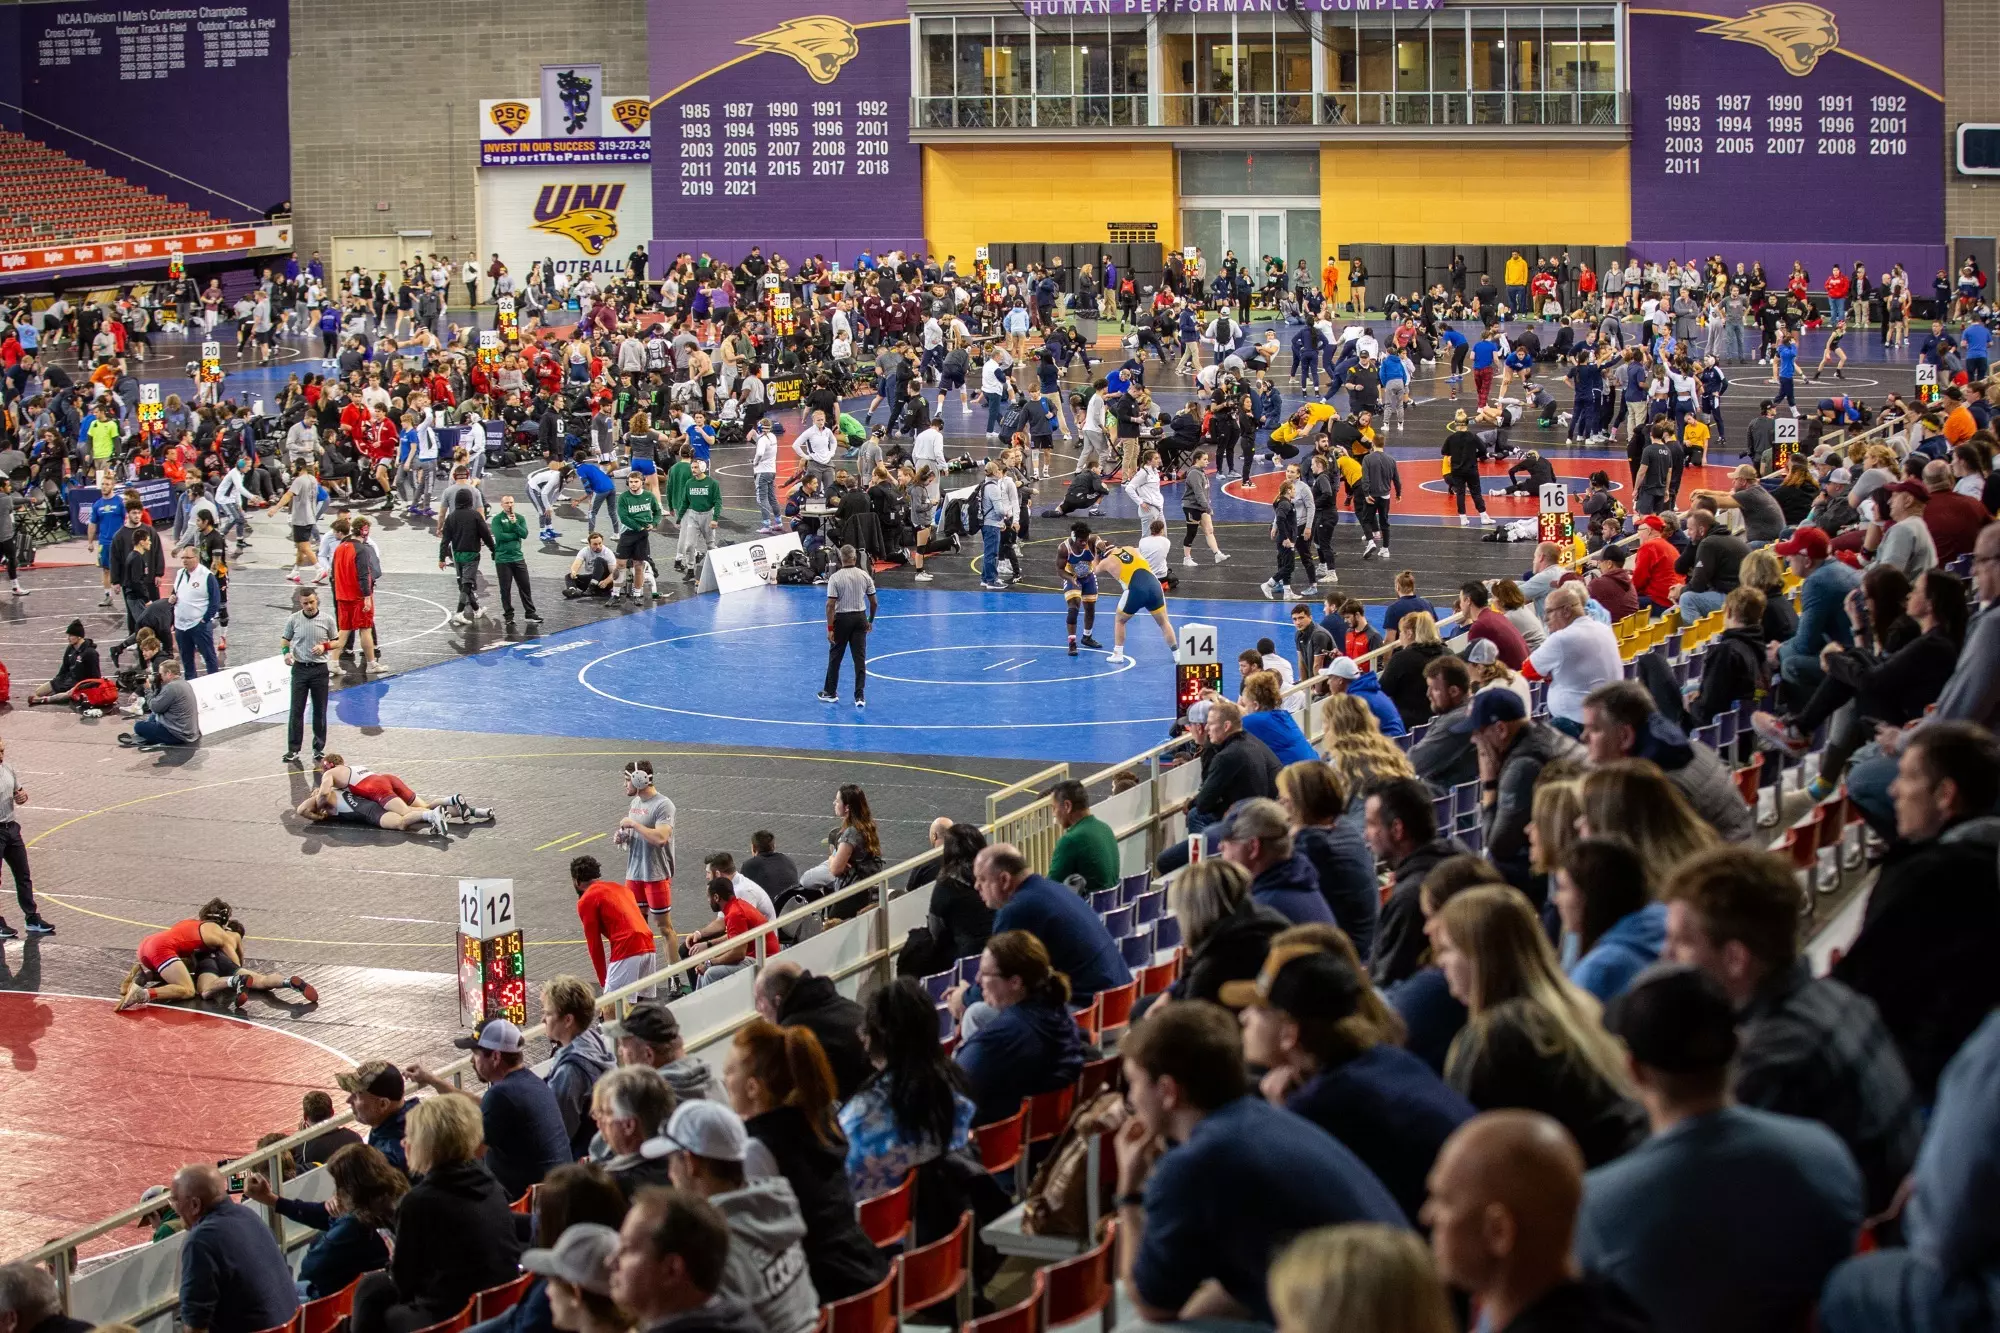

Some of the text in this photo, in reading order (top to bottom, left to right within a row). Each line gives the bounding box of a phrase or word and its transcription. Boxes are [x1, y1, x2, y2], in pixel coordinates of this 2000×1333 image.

[1030, 0, 1436, 14] HUMAN PERFORMANCE COMPLEX
[57, 6, 248, 24] NCAA Division I Men's Conference Champions
[116, 22, 187, 34] Indoor Track & Field
[197, 18, 276, 31] Outdoor Track & Field
[45, 28, 95, 38] Cross Country
[680, 101, 888, 118] 1985 1987 1990 1991 1992
[1665, 95, 1906, 112] 1985 1987 1990 1991 1992
[494, 108, 527, 121] PSC
[616, 105, 650, 118] PSC
[681, 121, 888, 138] 1993 1994 1995 1996 2001
[1665, 116, 1906, 134] 1993 1994 1995 1996 2001
[484, 141, 650, 153] INVEST IN OUR SUCCESS 319-273-24
[681, 141, 888, 157] 2003 2005 2007 2008 2010
[1665, 138, 1906, 155] 2003 2005 2007 2008 2010
[484, 152, 649, 163] SupportThePanthers.co
[681, 160, 889, 176] 2011 2014 2015 2017 2018
[1665, 158, 1700, 174] 2011
[682, 180, 756, 196] 2019 2021
[533, 184, 626, 222] UNI
[532, 260, 625, 274] OTBALL
[481, 336, 490, 344] 23
[205, 347, 217, 355] 20
[1919, 370, 1934, 380] 24
[148, 389, 157, 399] 21
[1778, 425, 1796, 437] 22
[1544, 491, 1564, 507] 16
[1541, 513, 1556, 525] 28
[1565, 525, 1572, 536] 3
[1186, 635, 1214, 656] 14
[1186, 664, 1219, 679] 14 17
[1190, 680, 1198, 695] 3
[462, 894, 479, 926] 12
[487, 892, 511, 925] 12
[495, 937, 502, 959] 3
[494, 953, 523, 978] 4 3
